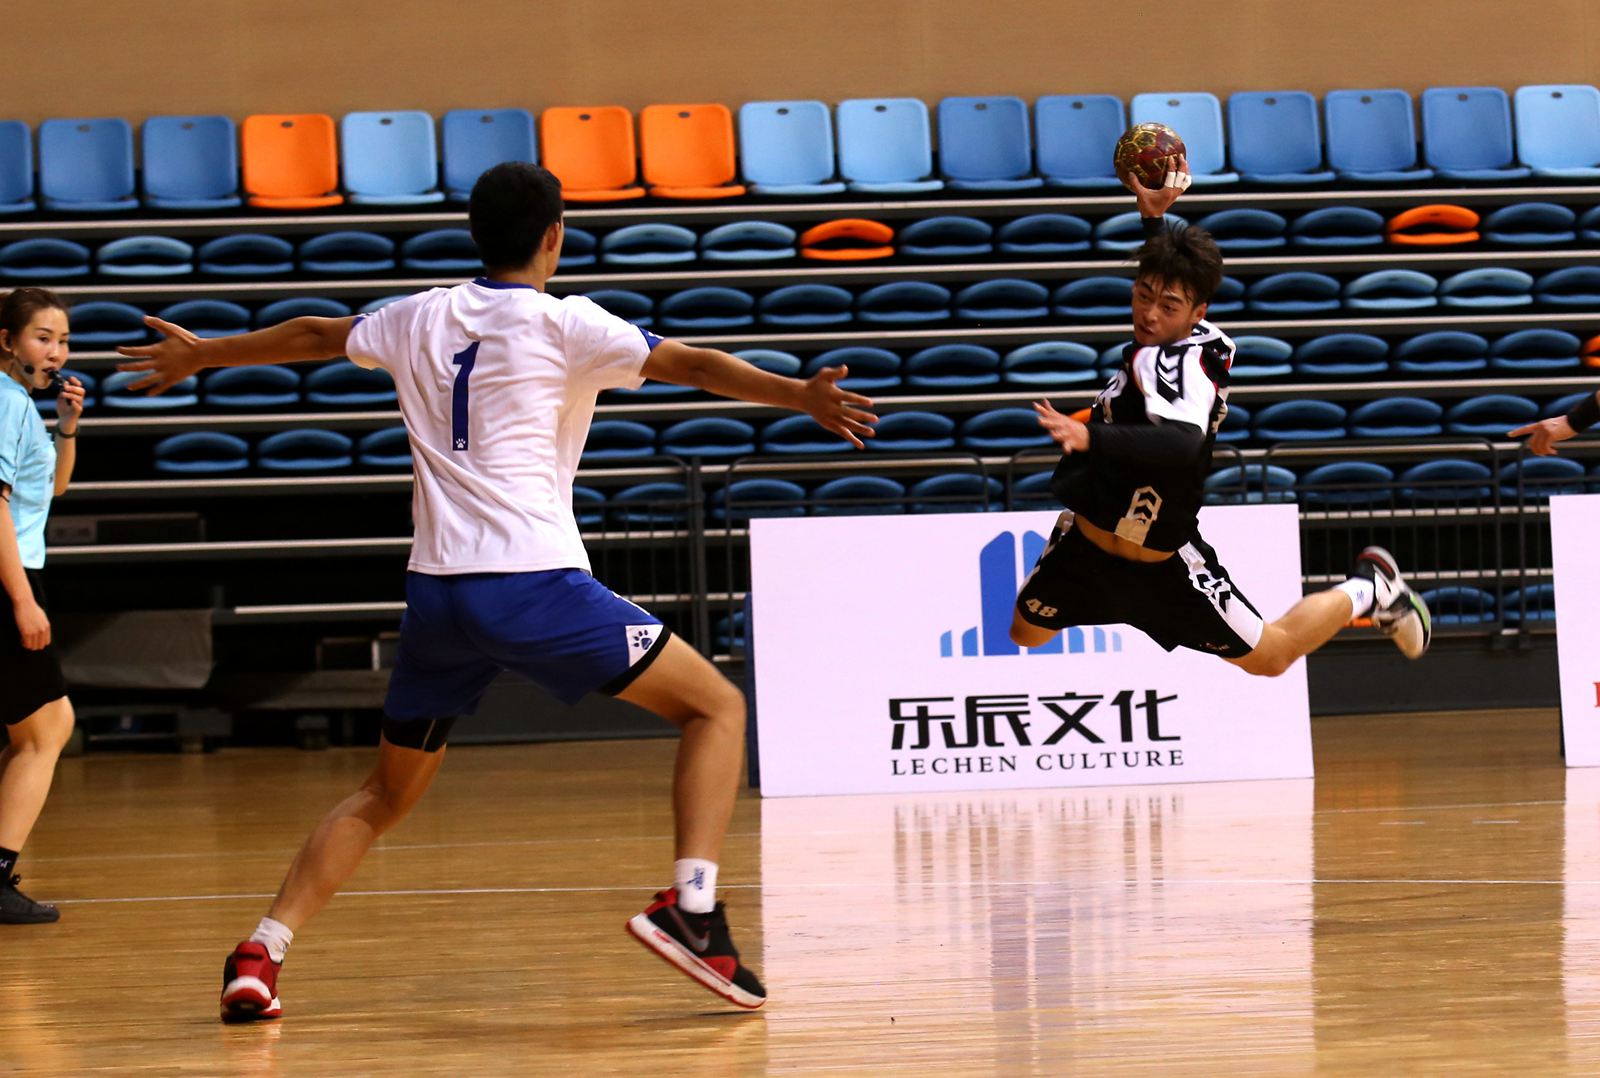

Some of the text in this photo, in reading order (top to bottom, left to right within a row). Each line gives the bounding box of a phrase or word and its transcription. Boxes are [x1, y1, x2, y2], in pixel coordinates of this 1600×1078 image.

[452, 341, 481, 451] 1
[1025, 598, 1058, 617] 48
[889, 690, 1181, 750] 乐辰文化
[892, 750, 1184, 776] LECHEN CULTURE
